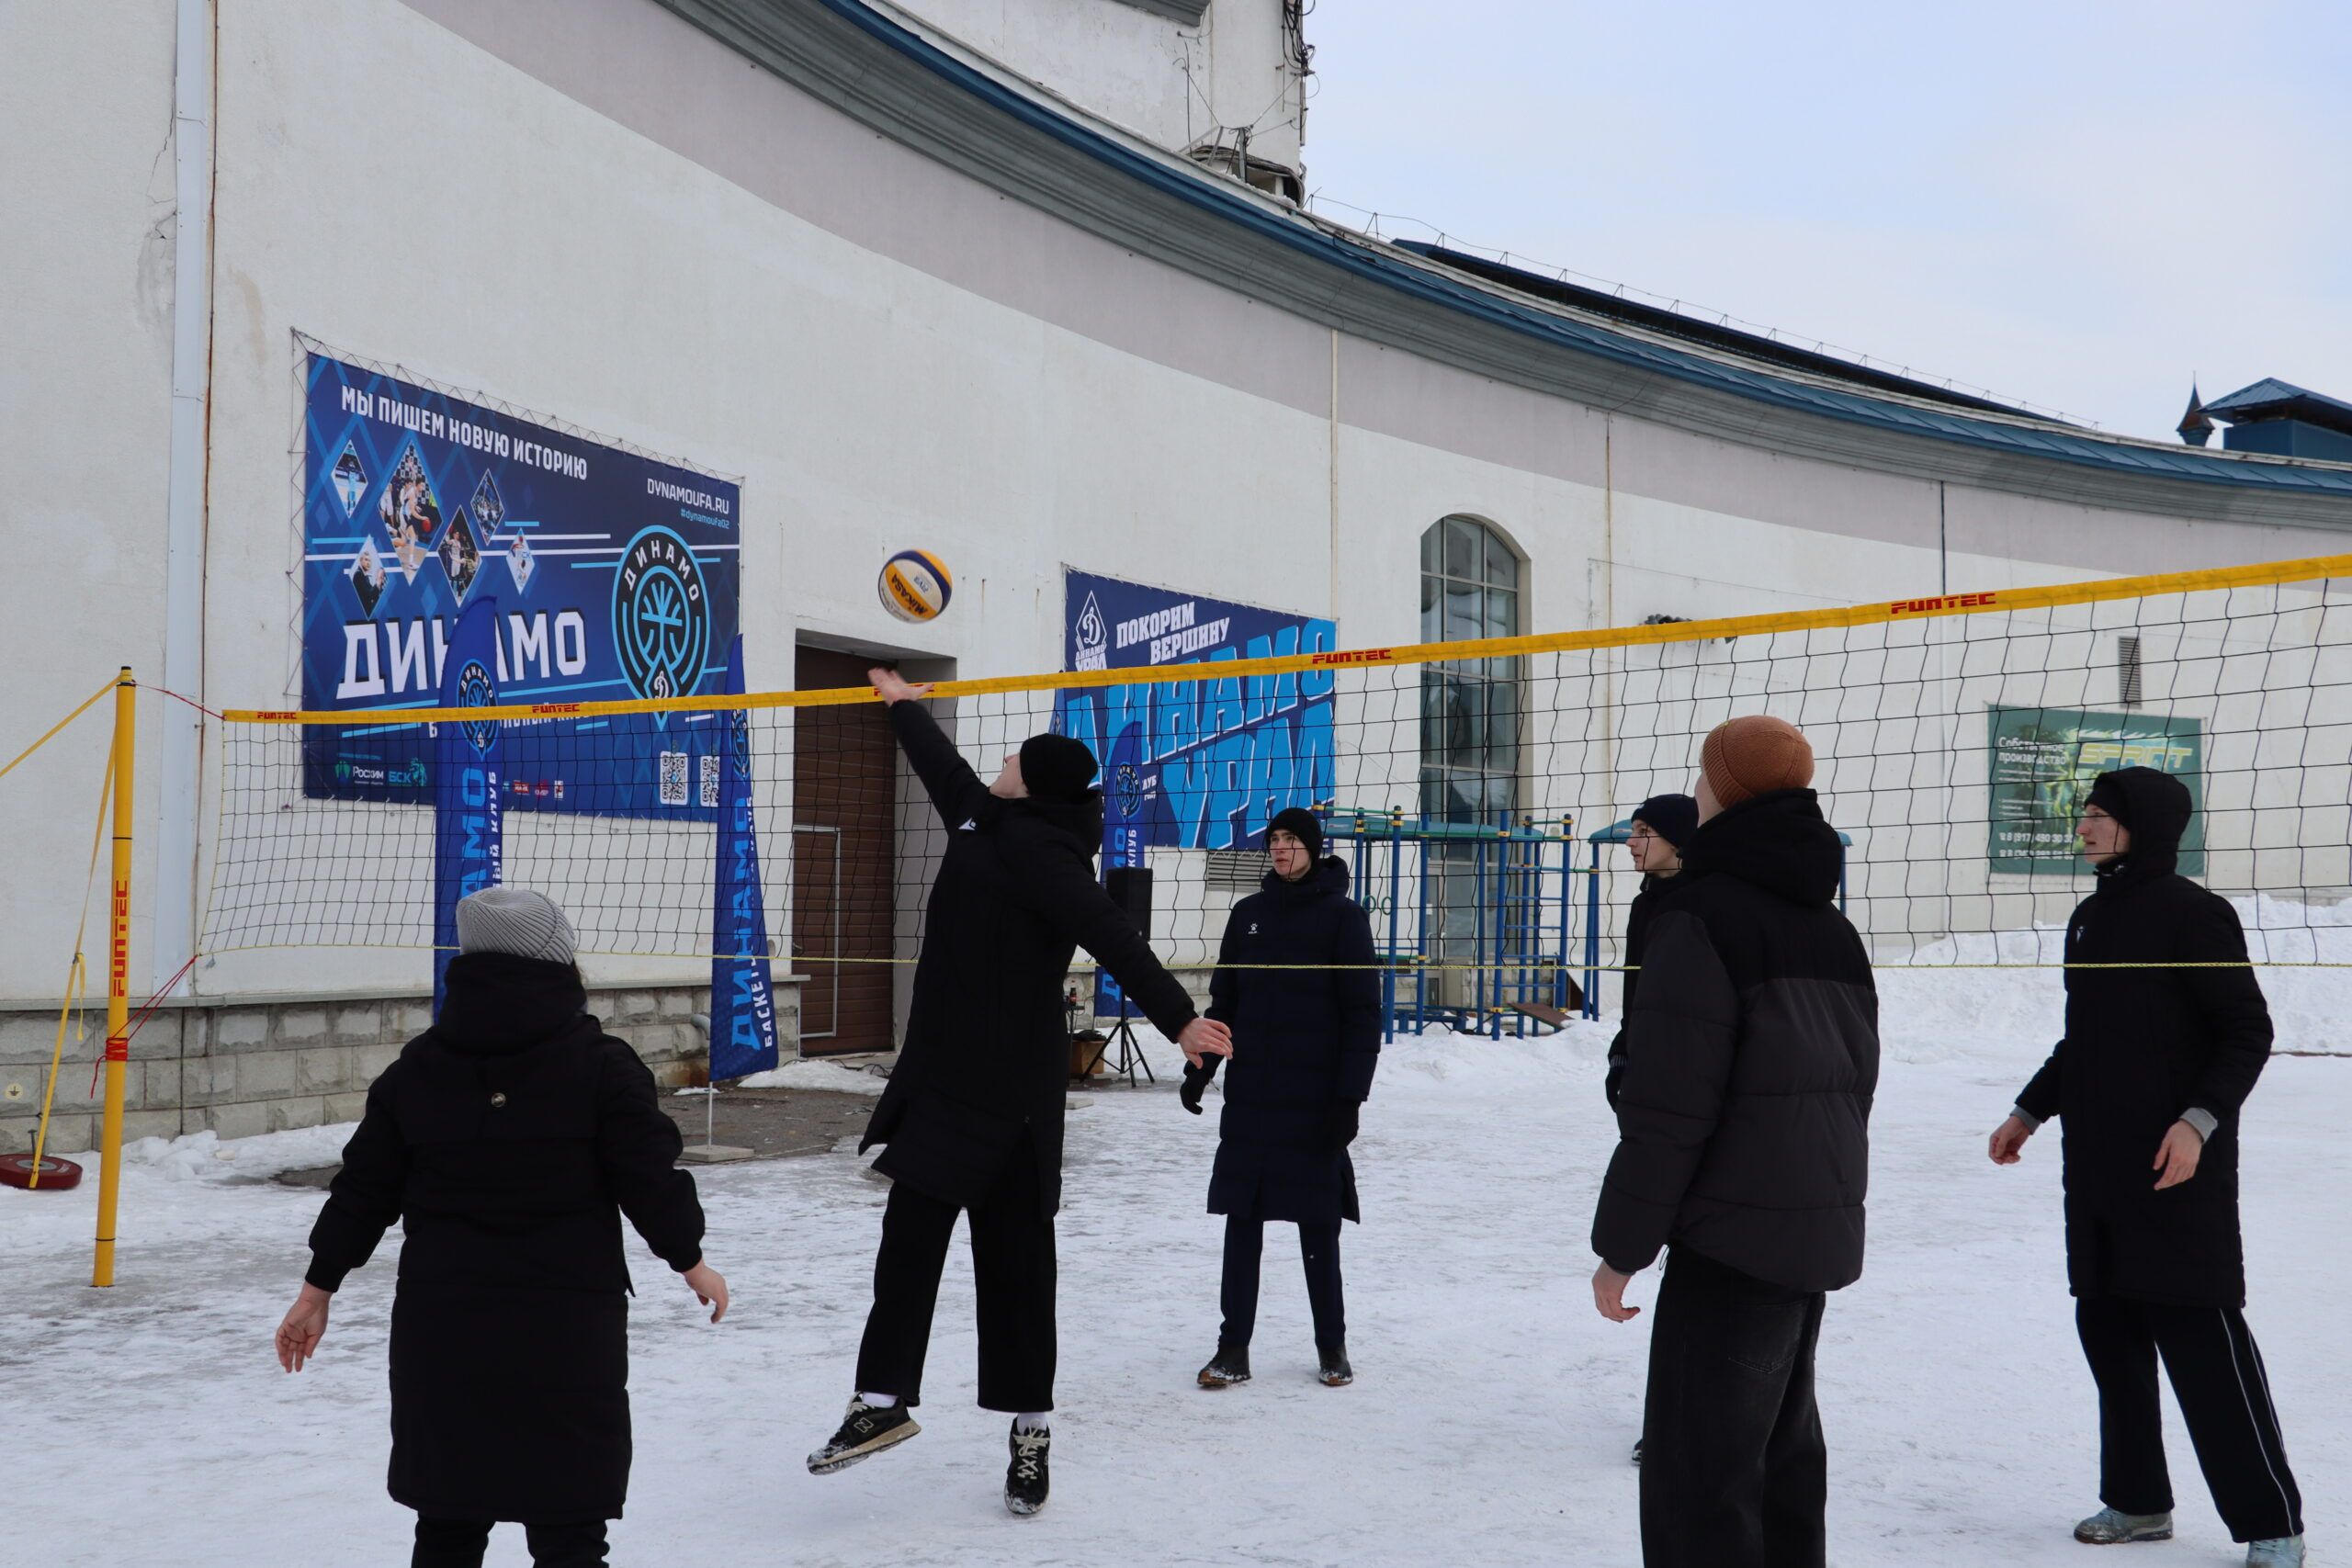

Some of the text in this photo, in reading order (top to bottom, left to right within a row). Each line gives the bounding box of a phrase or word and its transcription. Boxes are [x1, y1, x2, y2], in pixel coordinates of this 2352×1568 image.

[341, 385, 587, 480] МЫ ПИШЕМ НОВУЮ ИСТОРИЮ
[647, 478, 729, 514] DYNAMOUFA.RU
[681, 508, 729, 529] #dynamoufa02
[624, 539, 699, 602] ДИНАМО
[1116, 601, 1194, 649] ПОКОРИМ
[1891, 592, 1996, 615] FUNTEC
[1150, 616, 1230, 666] ВЕРШИНУ
[1312, 649, 1392, 664] FUNTEC
[532, 704, 580, 714] FUNTEC
[1162, 701, 1337, 850] УРАЛ
[1128, 829, 1137, 867] КЛУБ
[113, 880, 130, 997] FUNTEC
